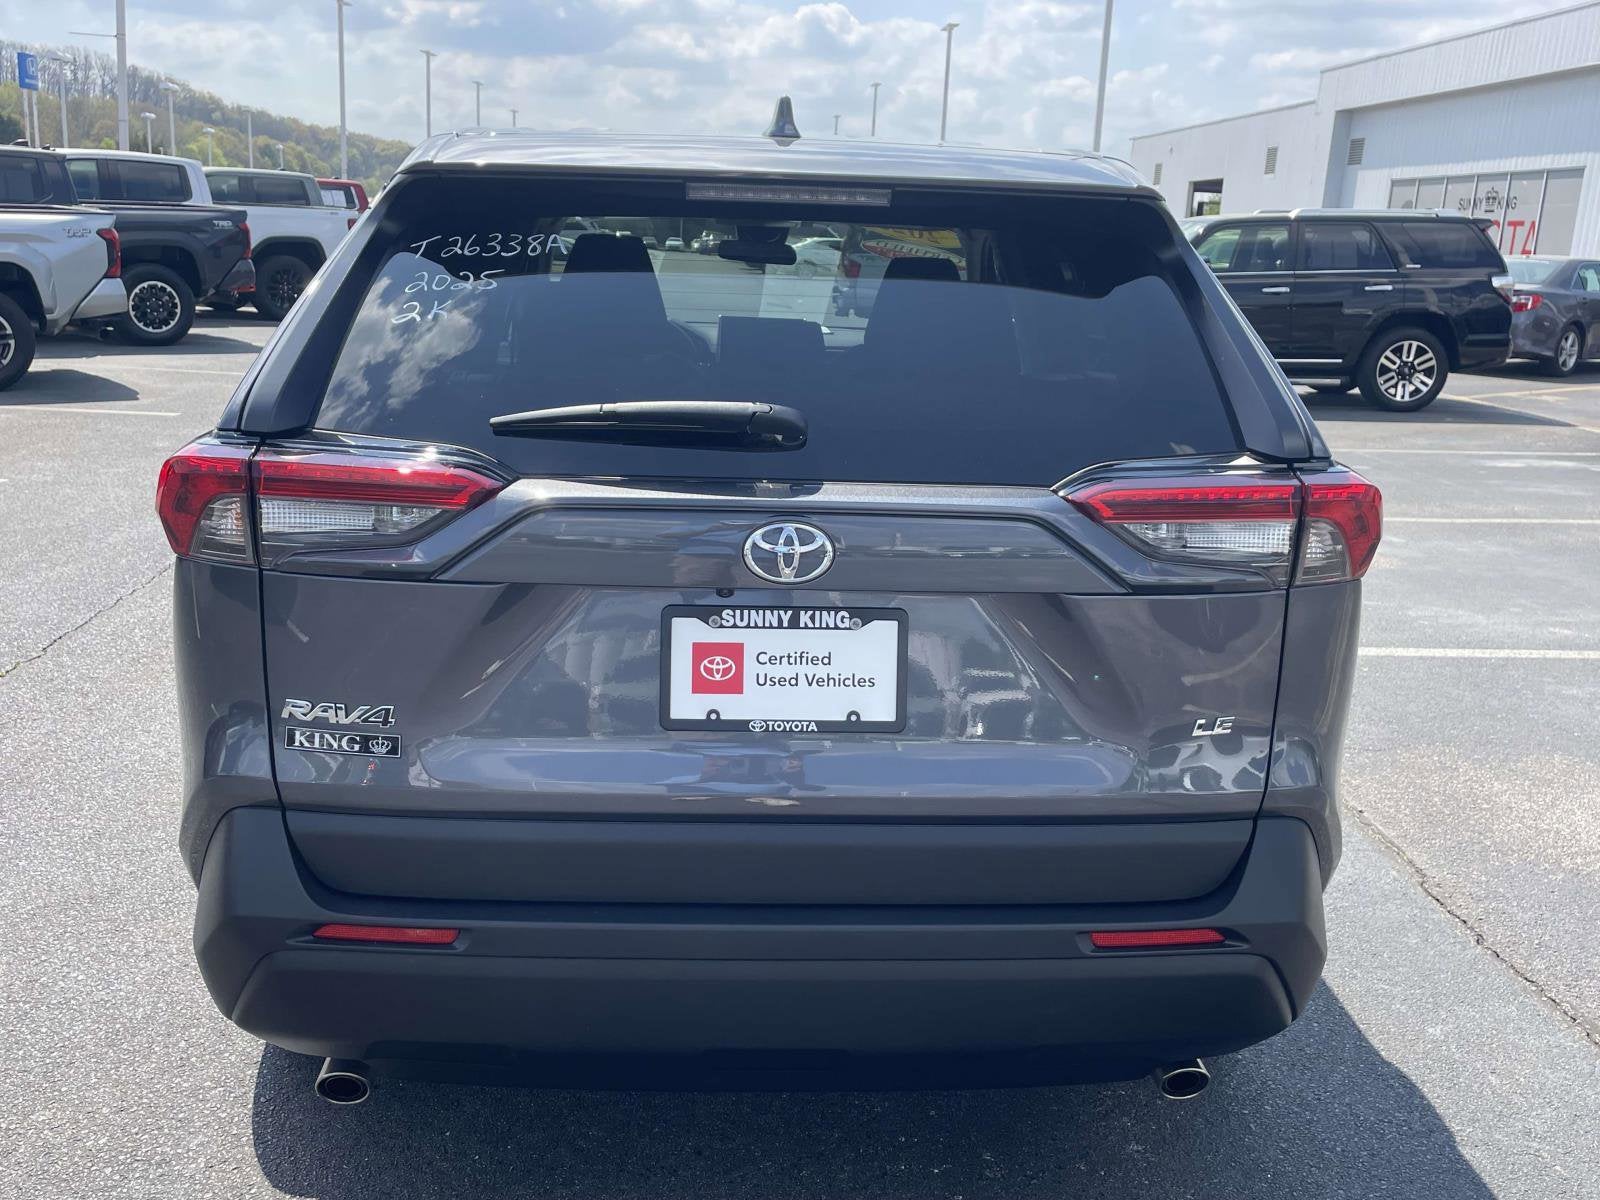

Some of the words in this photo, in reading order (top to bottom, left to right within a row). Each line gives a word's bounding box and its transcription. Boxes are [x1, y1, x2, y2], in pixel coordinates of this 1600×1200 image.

[405, 269, 505, 293] 2025
[721, 609, 793, 628] SUNNY
[799, 610, 850, 629] KING
[755, 651, 832, 666] Certified
[755, 672, 799, 687] Used
[804, 673, 876, 688] Vehicles
[281, 698, 396, 728] RAV4
[766, 720, 818, 733] TOYOTA
[1191, 716, 1236, 737] LE
[292, 730, 361, 752] KING
